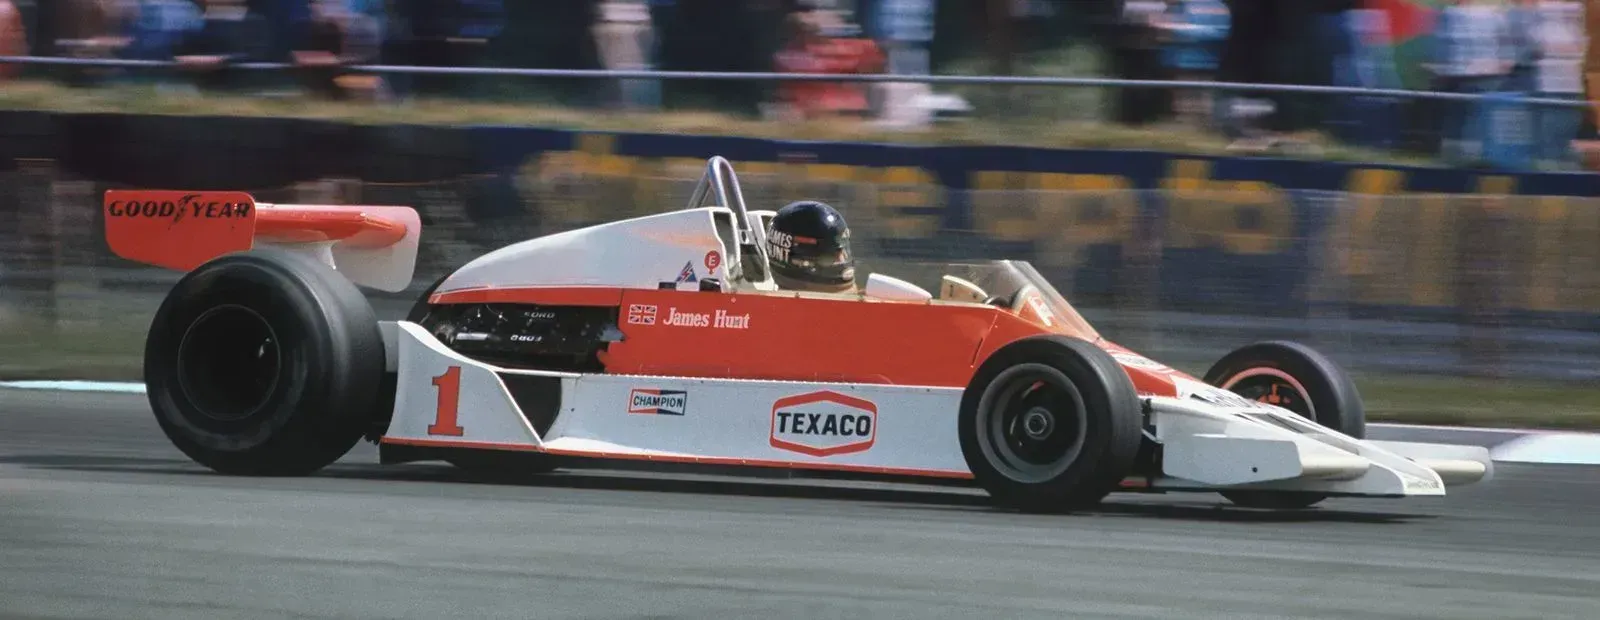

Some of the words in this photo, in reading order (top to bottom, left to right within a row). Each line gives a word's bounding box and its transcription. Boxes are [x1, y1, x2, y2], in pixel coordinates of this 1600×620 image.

[767, 228, 793, 249] AMES
[708, 254, 717, 267] E
[767, 244, 791, 263] UNT
[663, 307, 710, 328] James
[713, 309, 750, 329] Hunt
[427, 365, 465, 437] 1
[632, 392, 684, 408] CHAMPION
[776, 412, 872, 437] TEXACO
